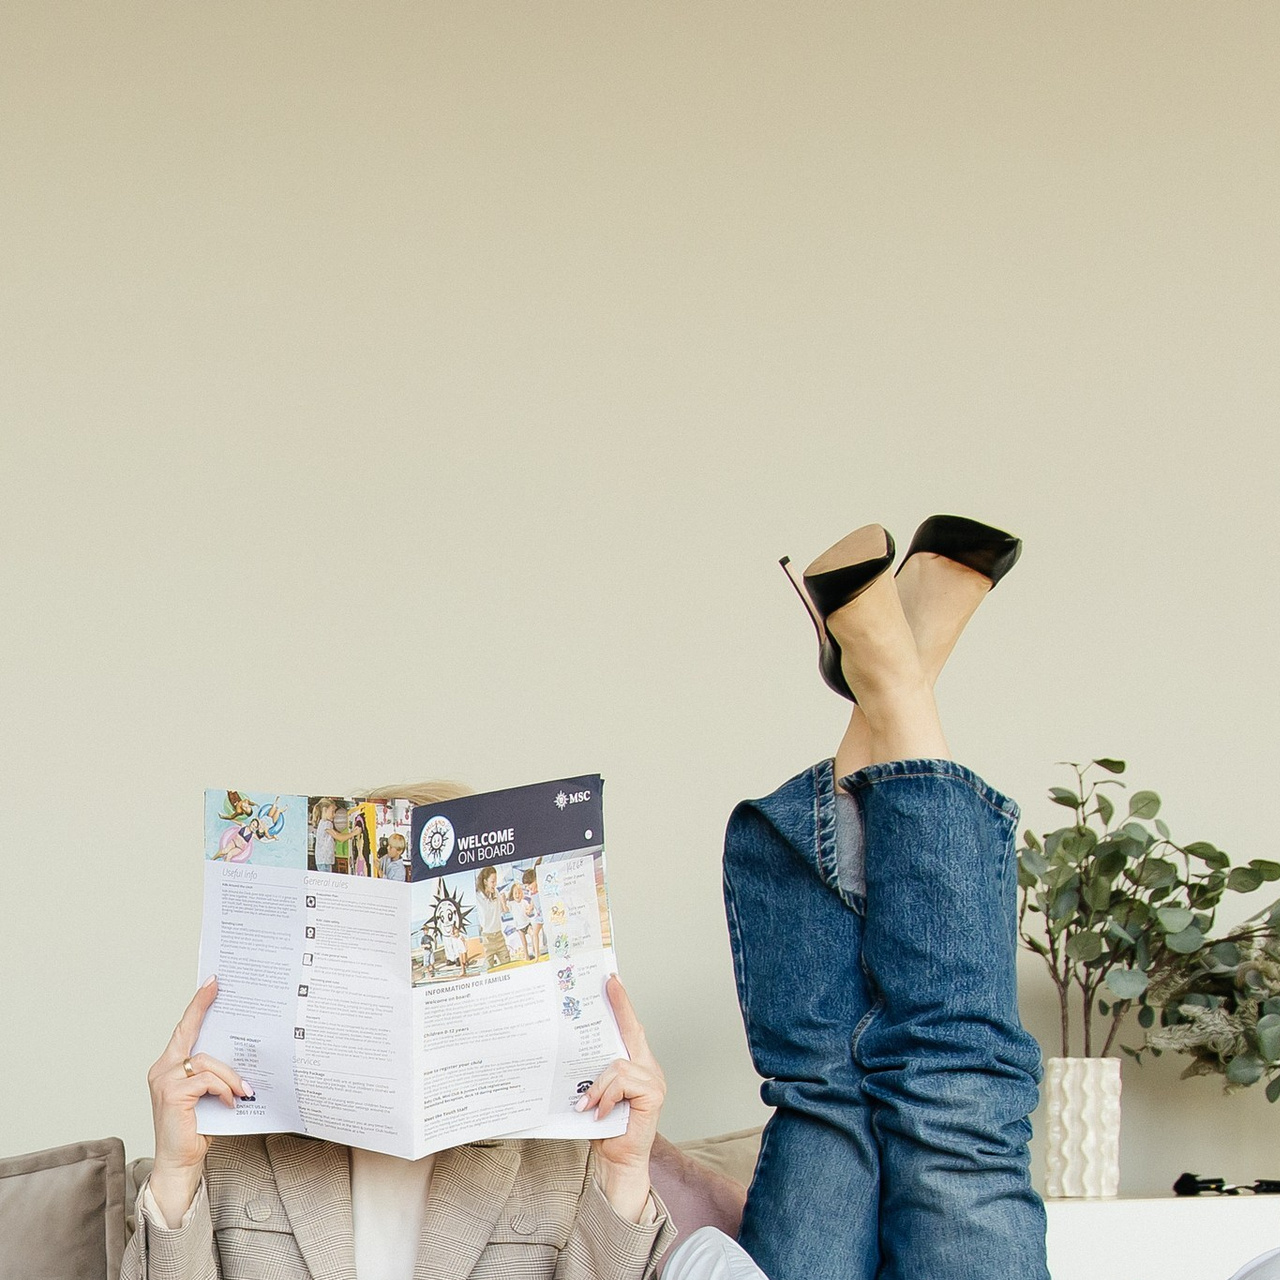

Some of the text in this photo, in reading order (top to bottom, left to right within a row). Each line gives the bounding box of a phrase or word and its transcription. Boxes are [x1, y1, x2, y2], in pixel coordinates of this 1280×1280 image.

[568, 791, 591, 804] MSC
[457, 828, 515, 850] WELCOME
[458, 842, 515, 865] ON BOARD
[222, 868, 243, 879] Useful
[303, 875, 348, 889] General rules
[425, 974, 511, 996] INFORMATION FOR FAMILIES
[292, 1056, 321, 1066] Services
